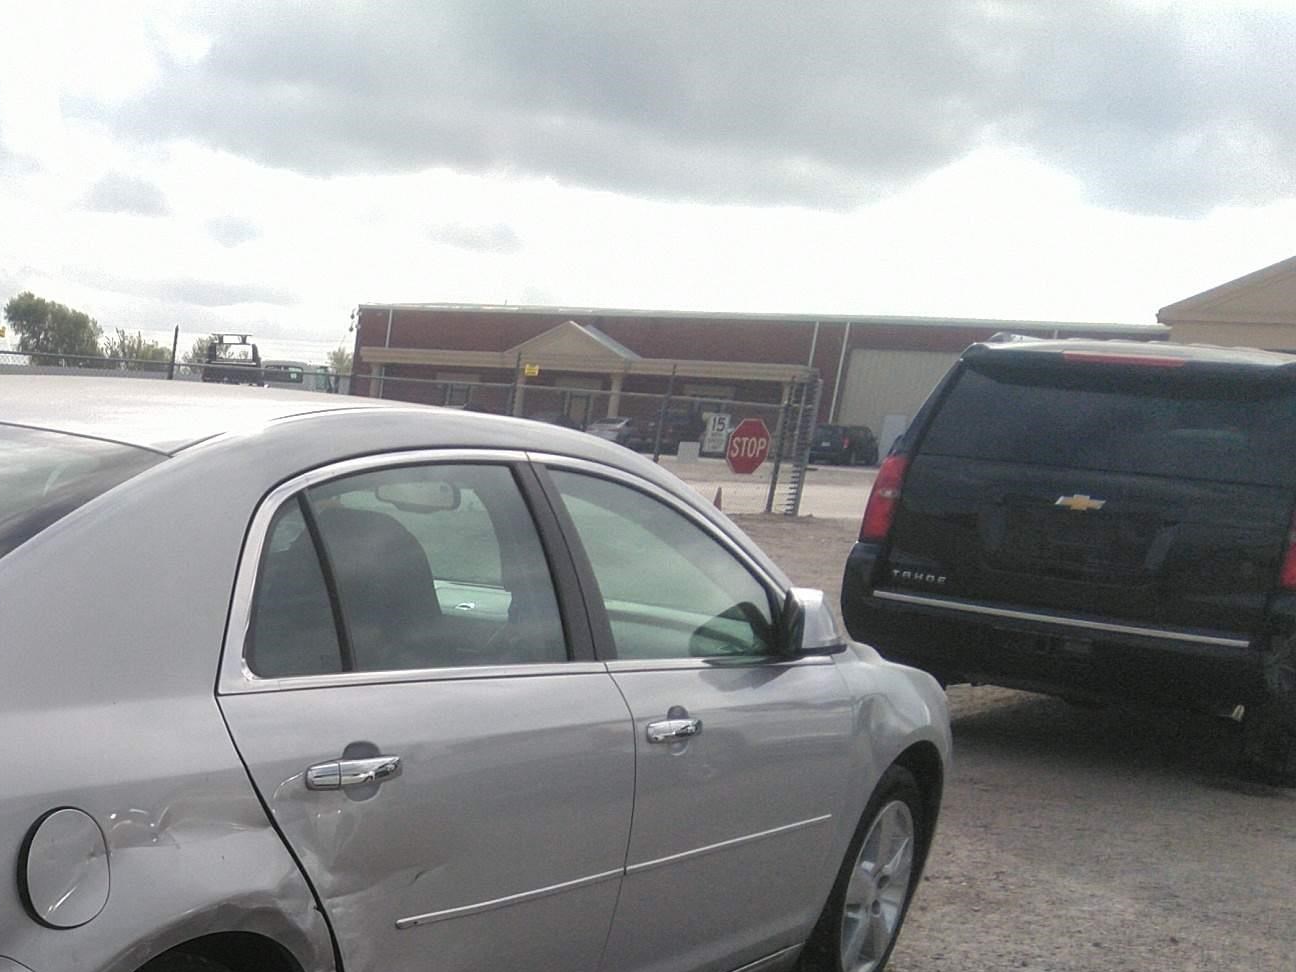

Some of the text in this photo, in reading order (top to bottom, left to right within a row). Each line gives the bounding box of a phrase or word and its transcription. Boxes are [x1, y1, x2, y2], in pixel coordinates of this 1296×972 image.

[711, 416, 726, 432] 15
[730, 436, 767, 458] STOP
[892, 568, 947, 584] TAHOE
